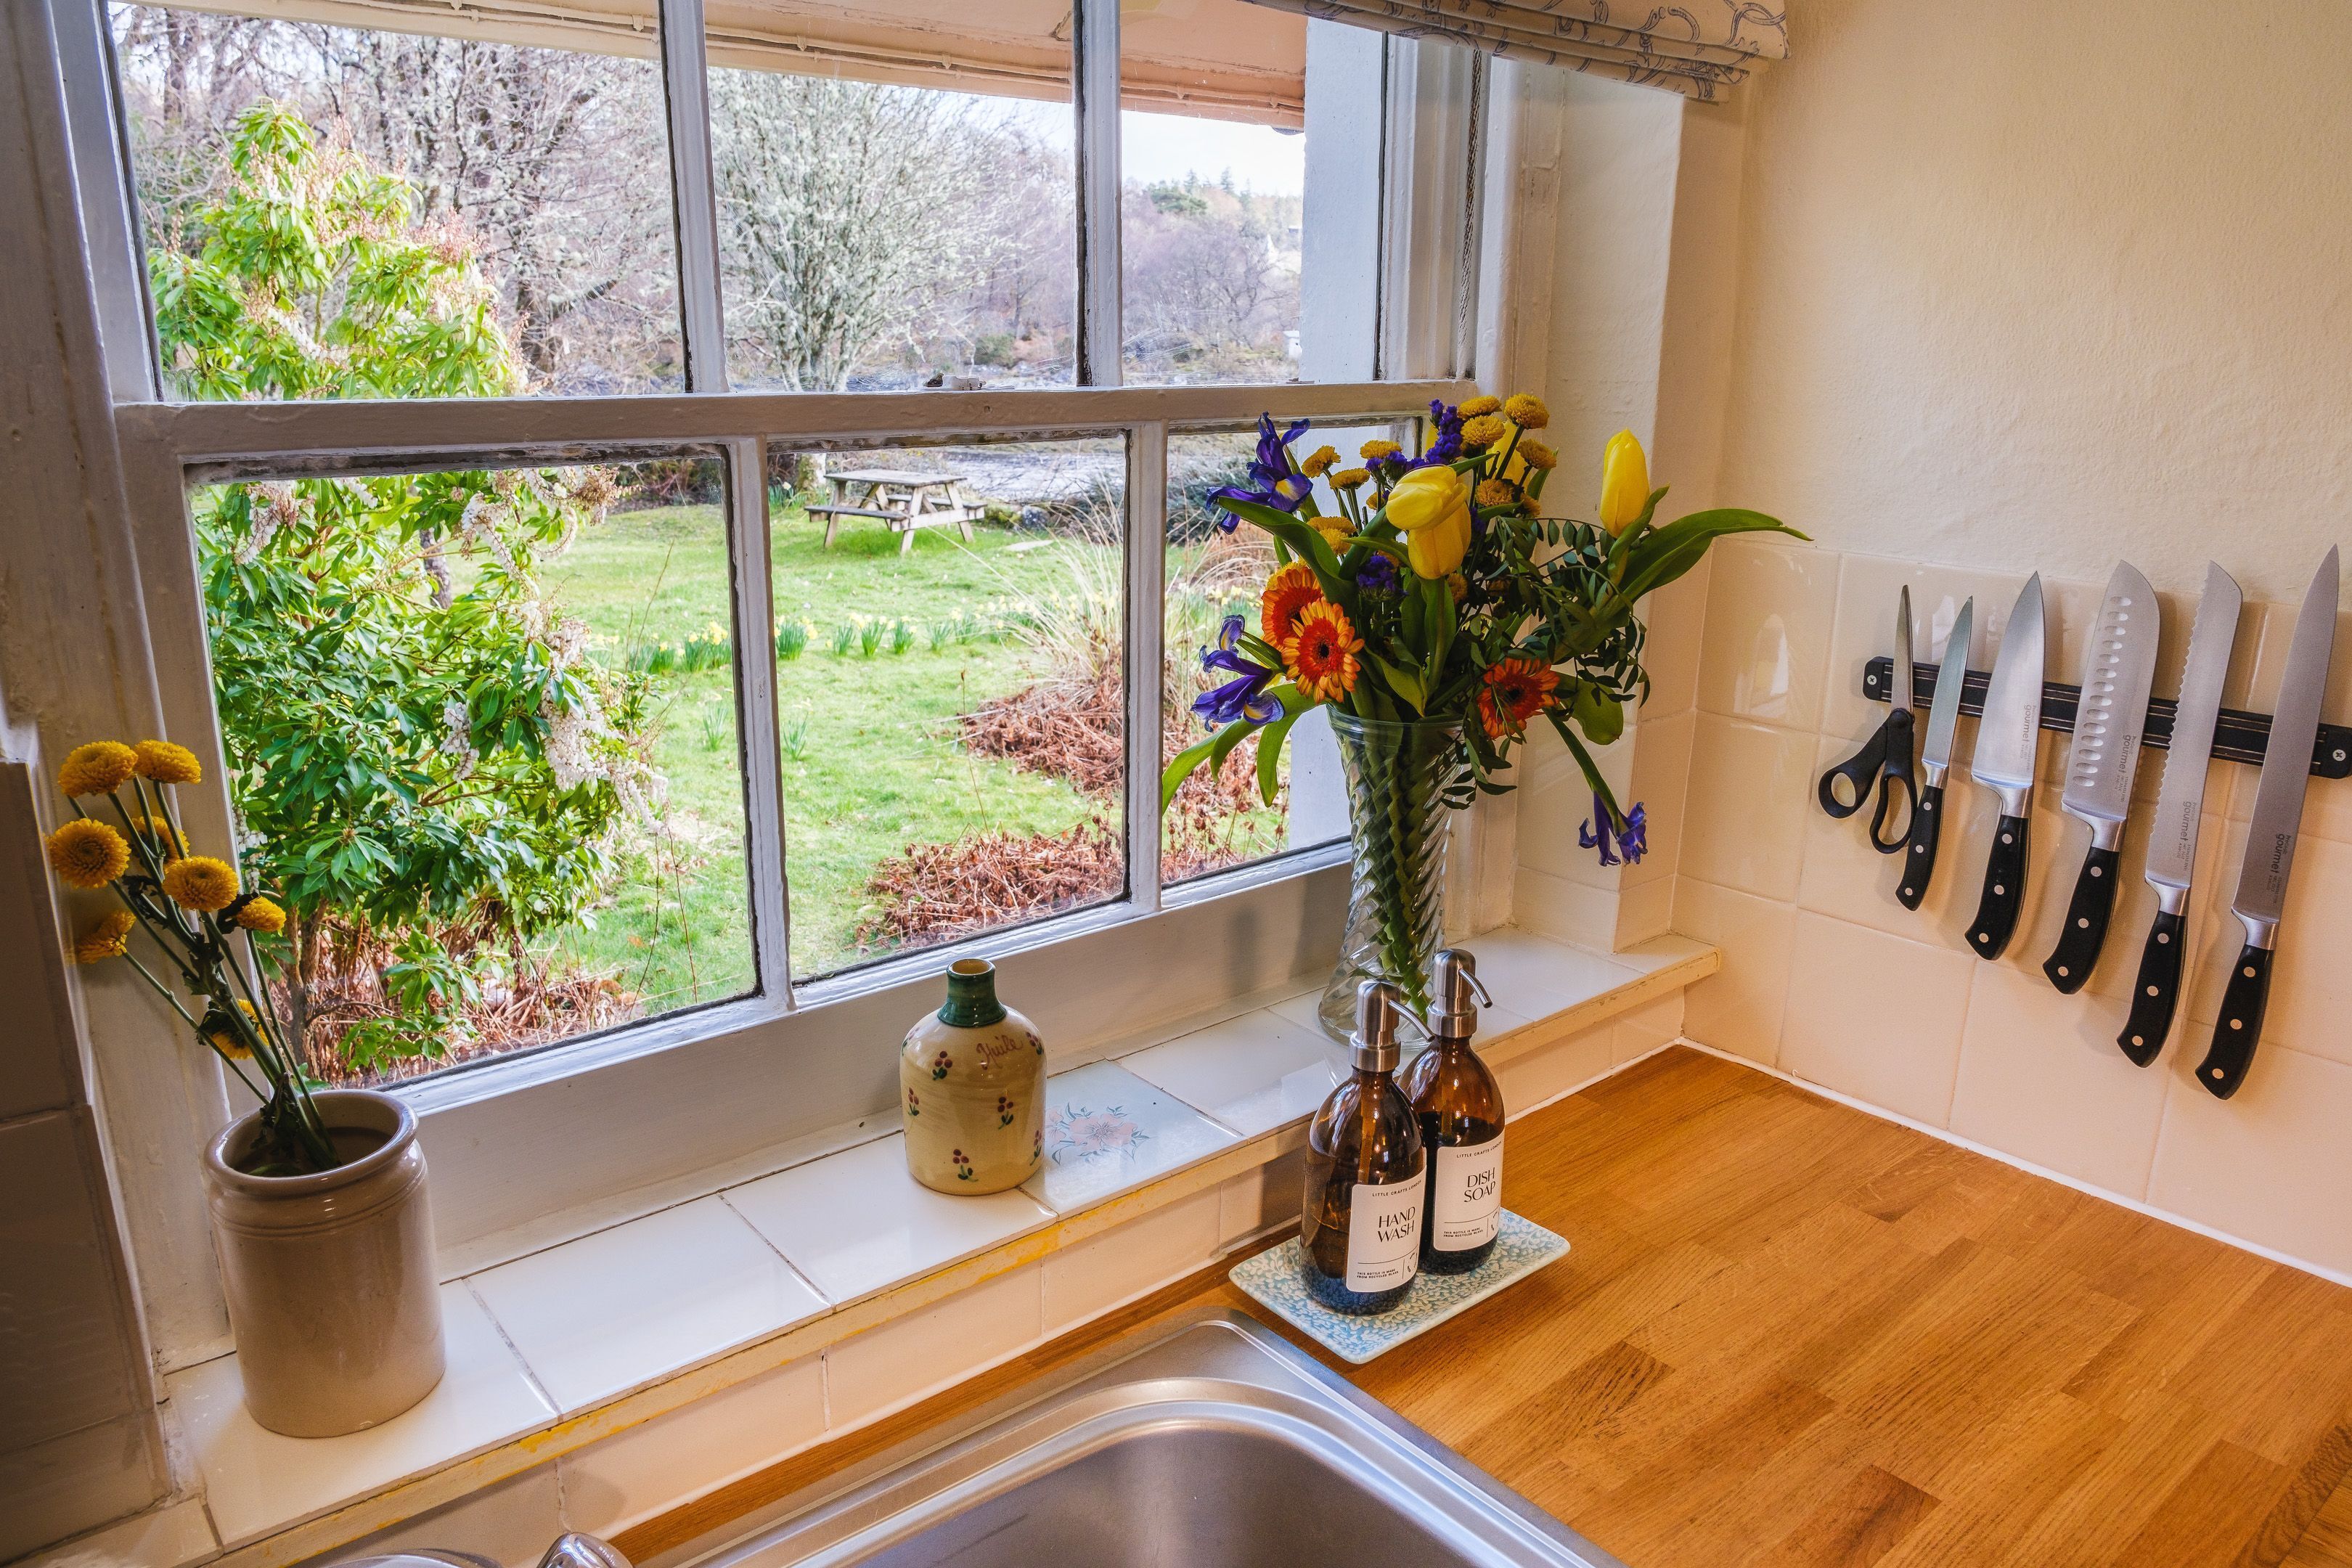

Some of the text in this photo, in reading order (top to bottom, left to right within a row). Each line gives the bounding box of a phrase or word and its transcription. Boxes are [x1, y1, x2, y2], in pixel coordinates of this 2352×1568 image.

[2022, 704, 2032, 742] gourmet
[2118, 735, 2131, 773] gourmet
[2180, 801, 2192, 841] gourmet
[2270, 833, 2284, 874] gourmet
[976, 1034, 1024, 1069] Huile
[1408, 1179, 1422, 1191] LONDON
[1463, 1180, 1496, 1203] SOAP
[1467, 1167, 1495, 1188] DISH
[1377, 1220, 1415, 1242] WASH
[1379, 1206, 1416, 1228] HAND
